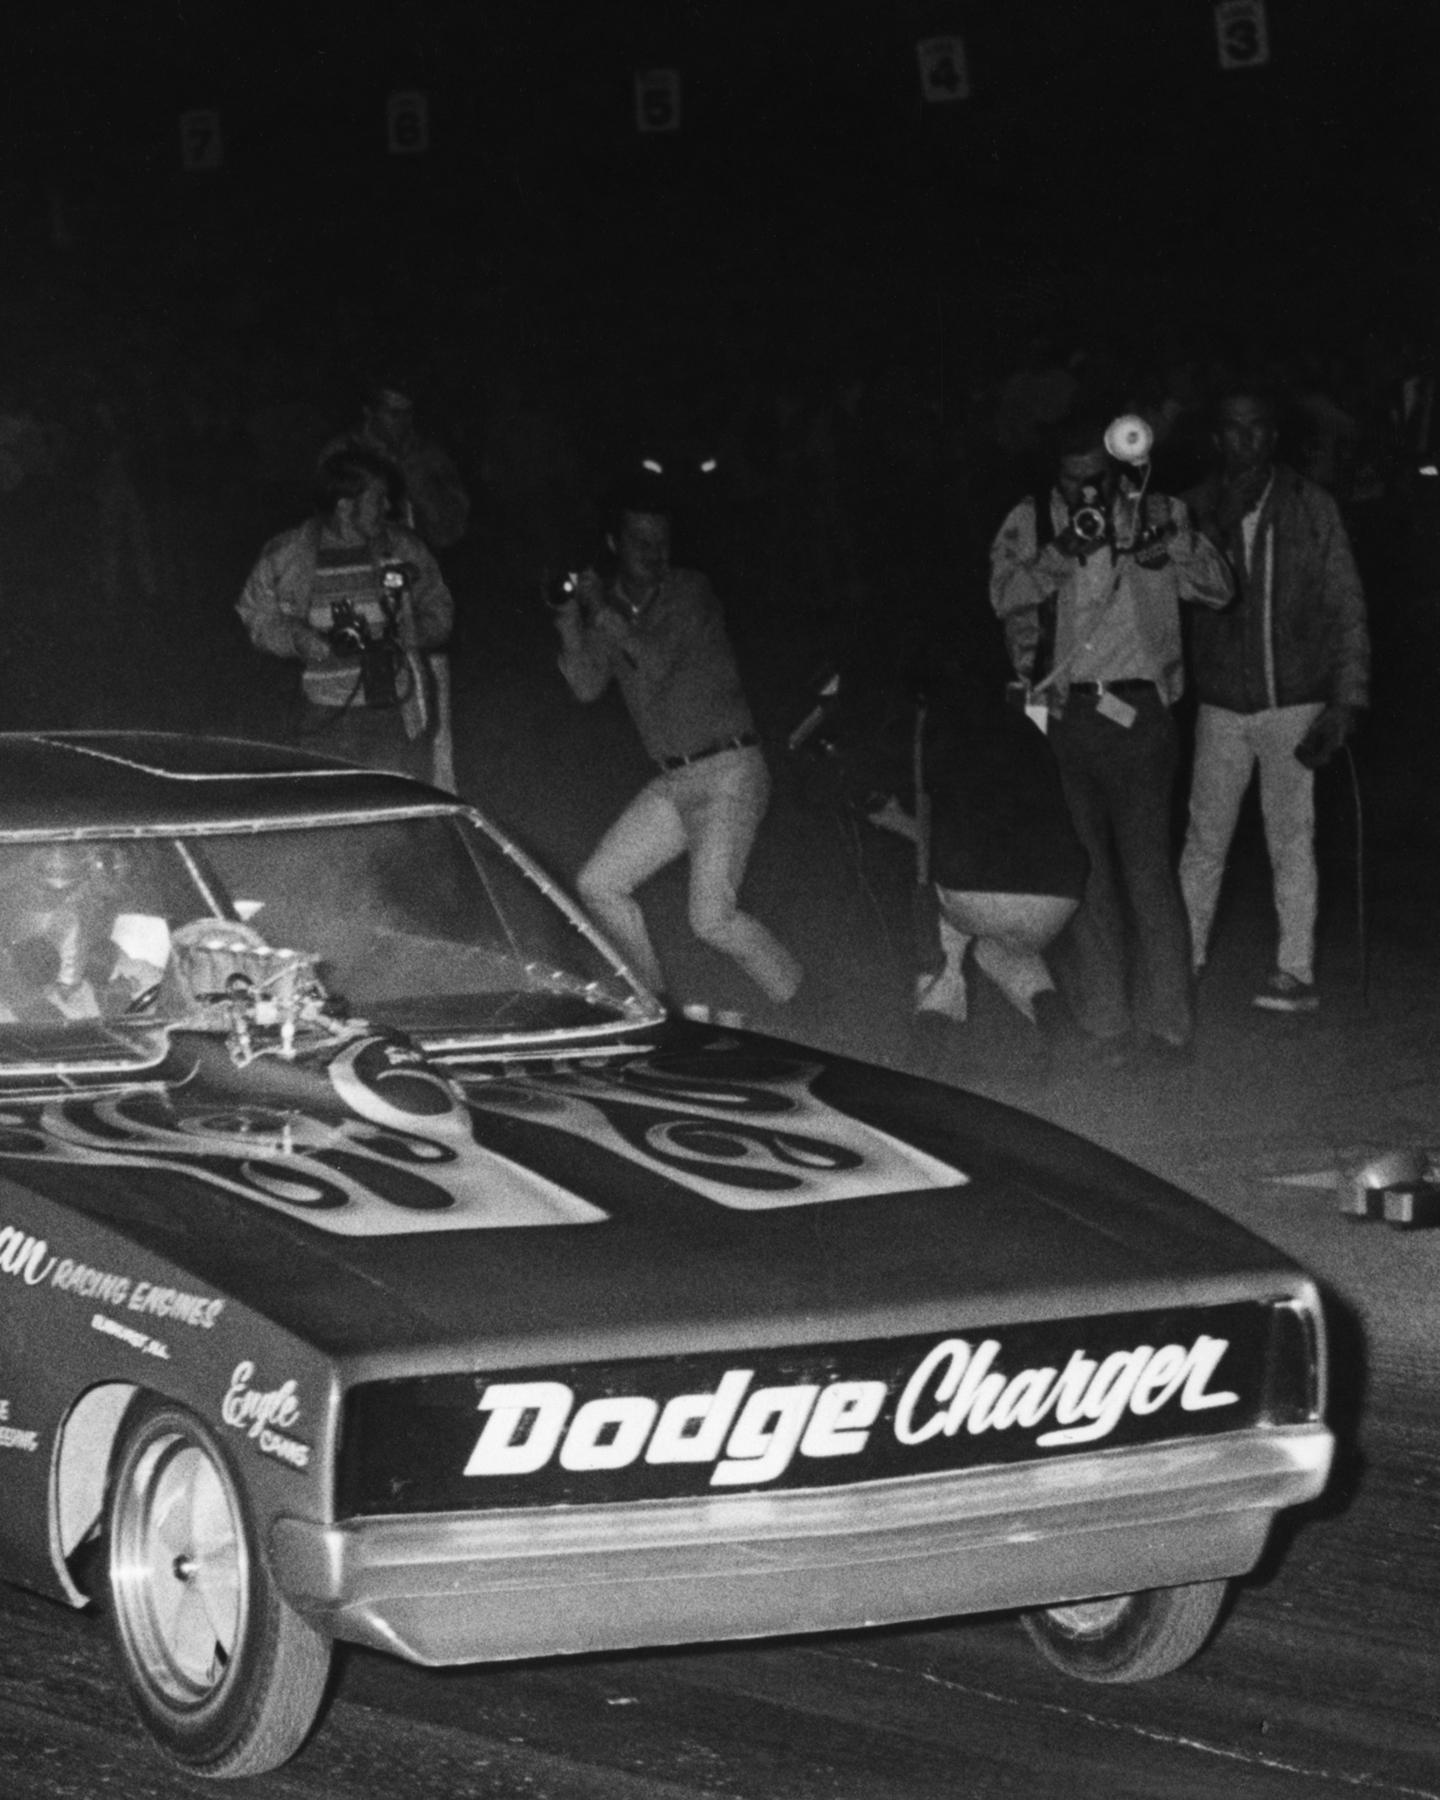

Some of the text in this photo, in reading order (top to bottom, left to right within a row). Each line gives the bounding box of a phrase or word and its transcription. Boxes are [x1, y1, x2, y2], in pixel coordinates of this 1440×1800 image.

[1225, 17, 1257, 61] 3
[644, 90, 673, 126] 5
[53, 1258, 128, 1306] RACING
[127, 1281, 226, 1329] ENGINES
[464, 1335, 1240, 1485] Dodge Charger
